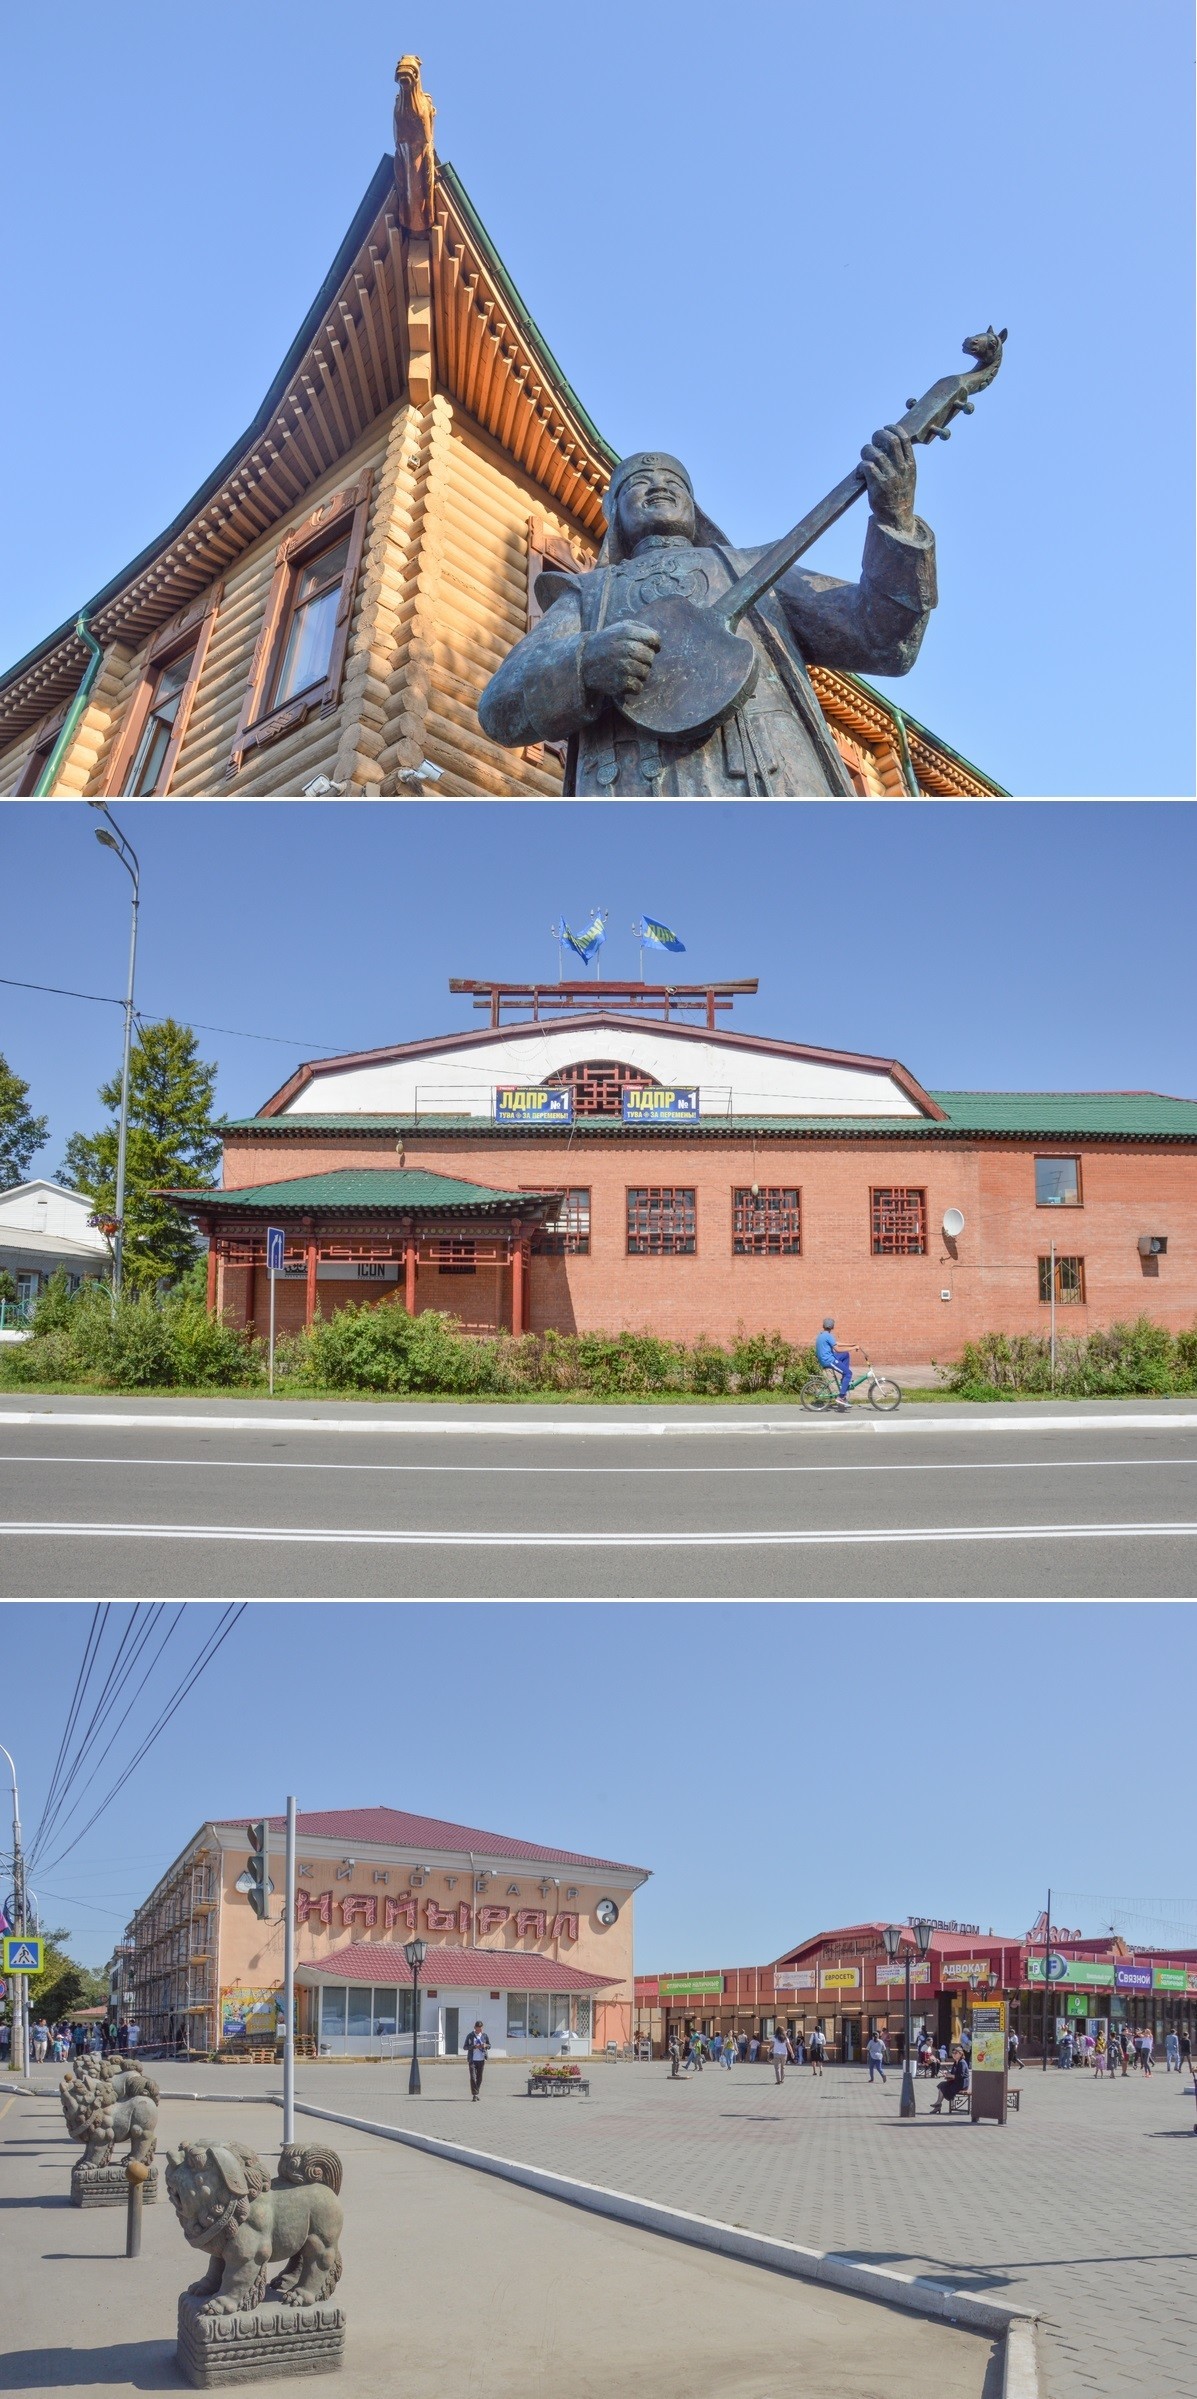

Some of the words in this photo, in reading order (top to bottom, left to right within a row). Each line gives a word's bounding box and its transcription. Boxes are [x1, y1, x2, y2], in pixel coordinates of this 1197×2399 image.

[499, 1091, 548, 1111] ЛДПР
[627, 1091, 676, 1110] ЛДПР
[357, 1263, 385, 1276] ICON
[298, 1864, 579, 1901] КИНОТЕАТР
[295, 1887, 580, 1941] НАЙЫРАЛ
[960, 1923, 980, 1935] ДОМ
[824, 1973, 855, 1981] ЕВРОСЕТЬ
[943, 1963, 987, 1975] АДВОКАТ
